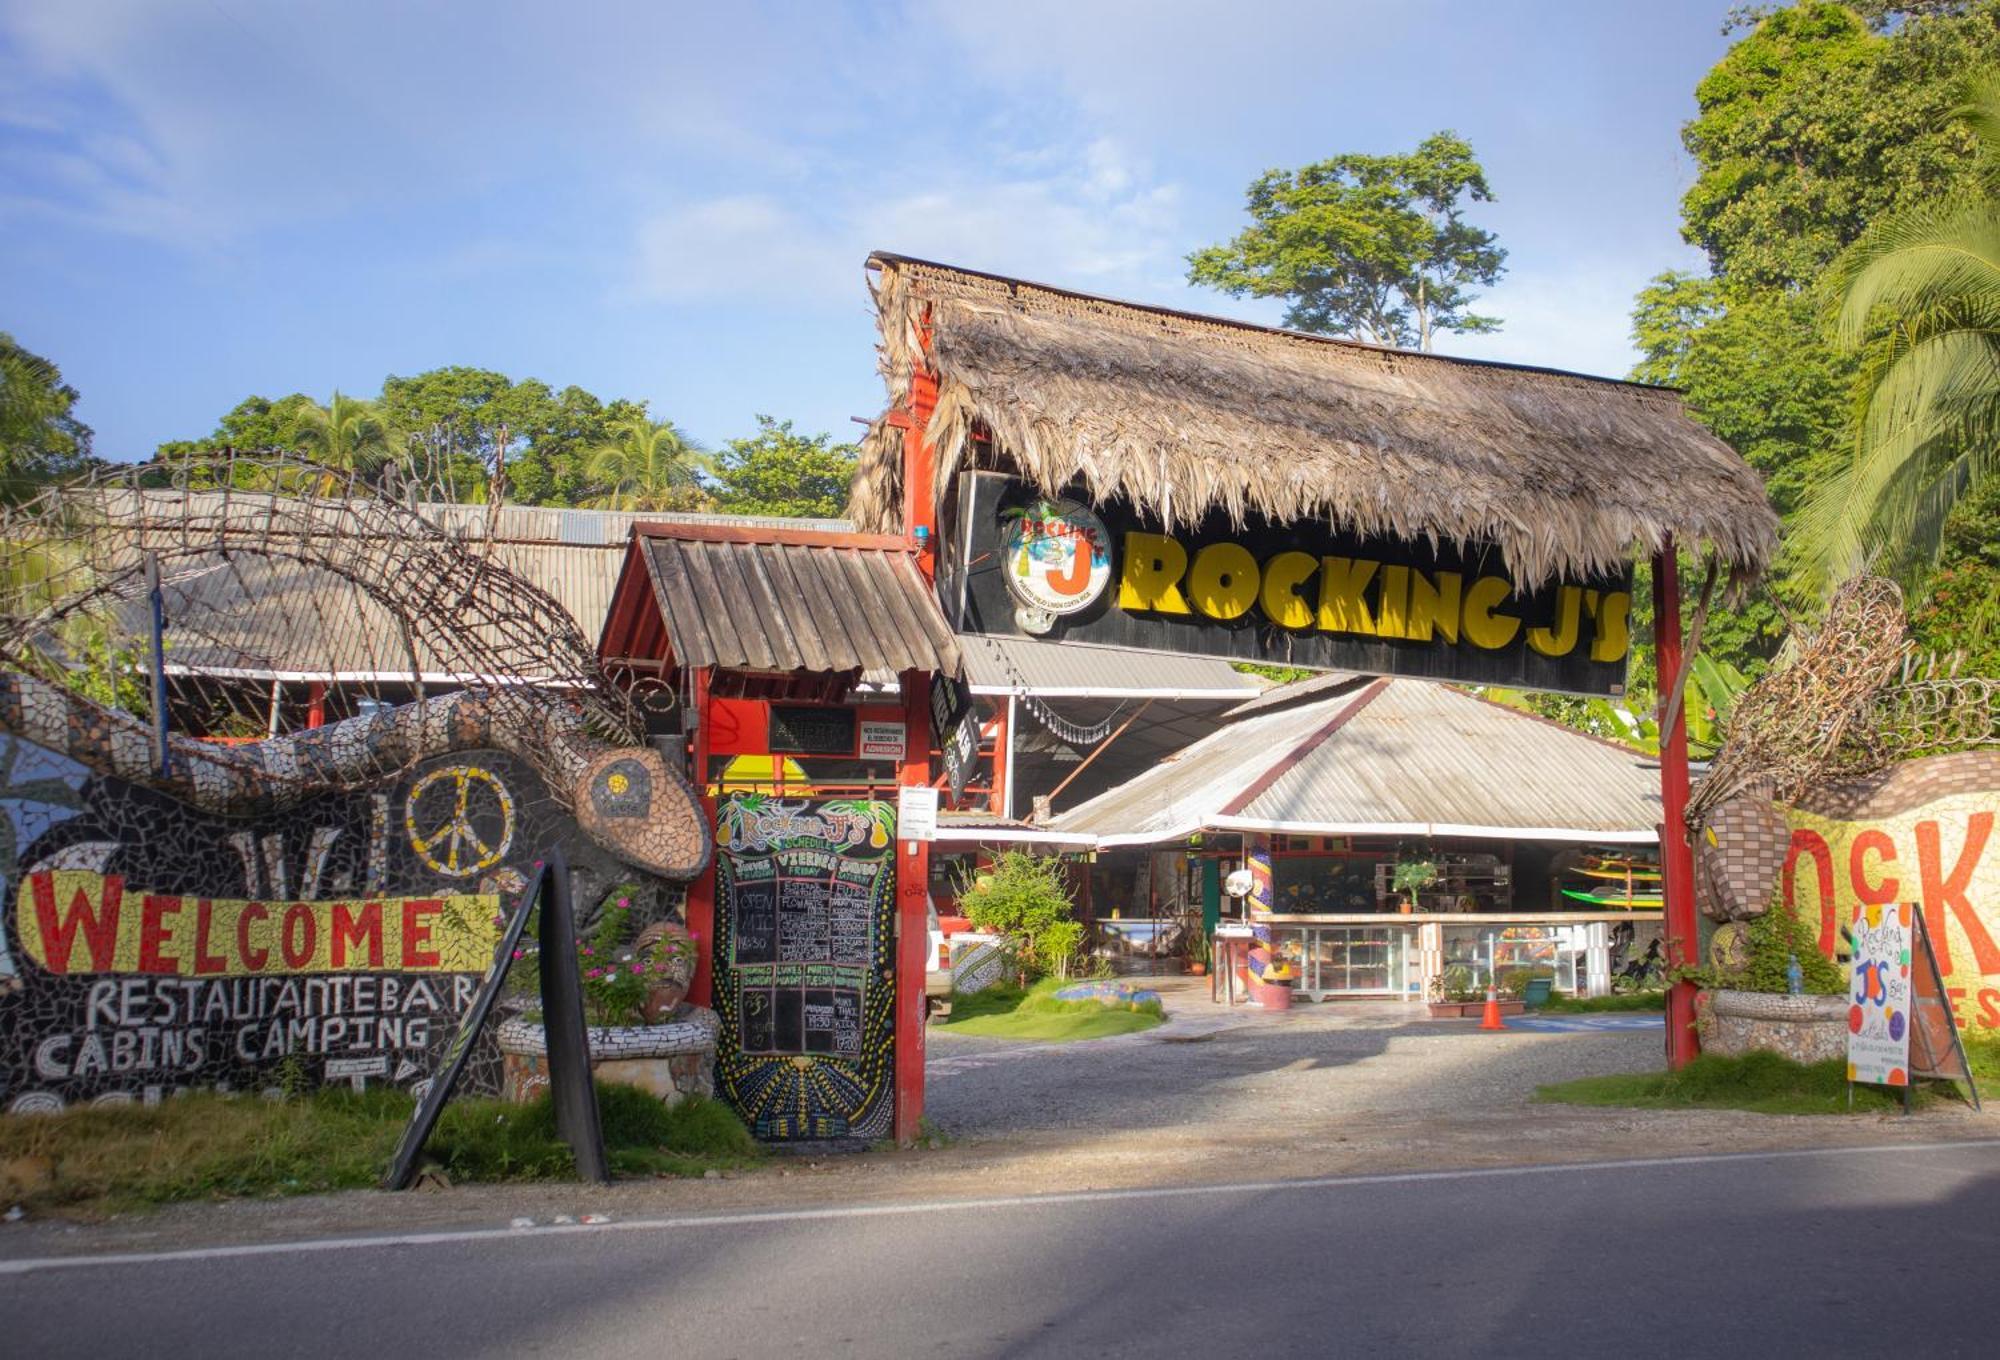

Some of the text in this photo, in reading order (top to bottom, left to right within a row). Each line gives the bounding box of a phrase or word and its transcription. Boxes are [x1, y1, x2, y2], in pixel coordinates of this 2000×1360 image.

[1119, 531, 1630, 663] ROCKING J'S
[785, 837, 832, 849] SCHEDULE
[788, 866, 820, 876] FRIDAY
[740, 893, 774, 910] OPEN
[31, 868, 444, 975] WELCOME
[36, 1016, 429, 1078] CABINS CAMPING
